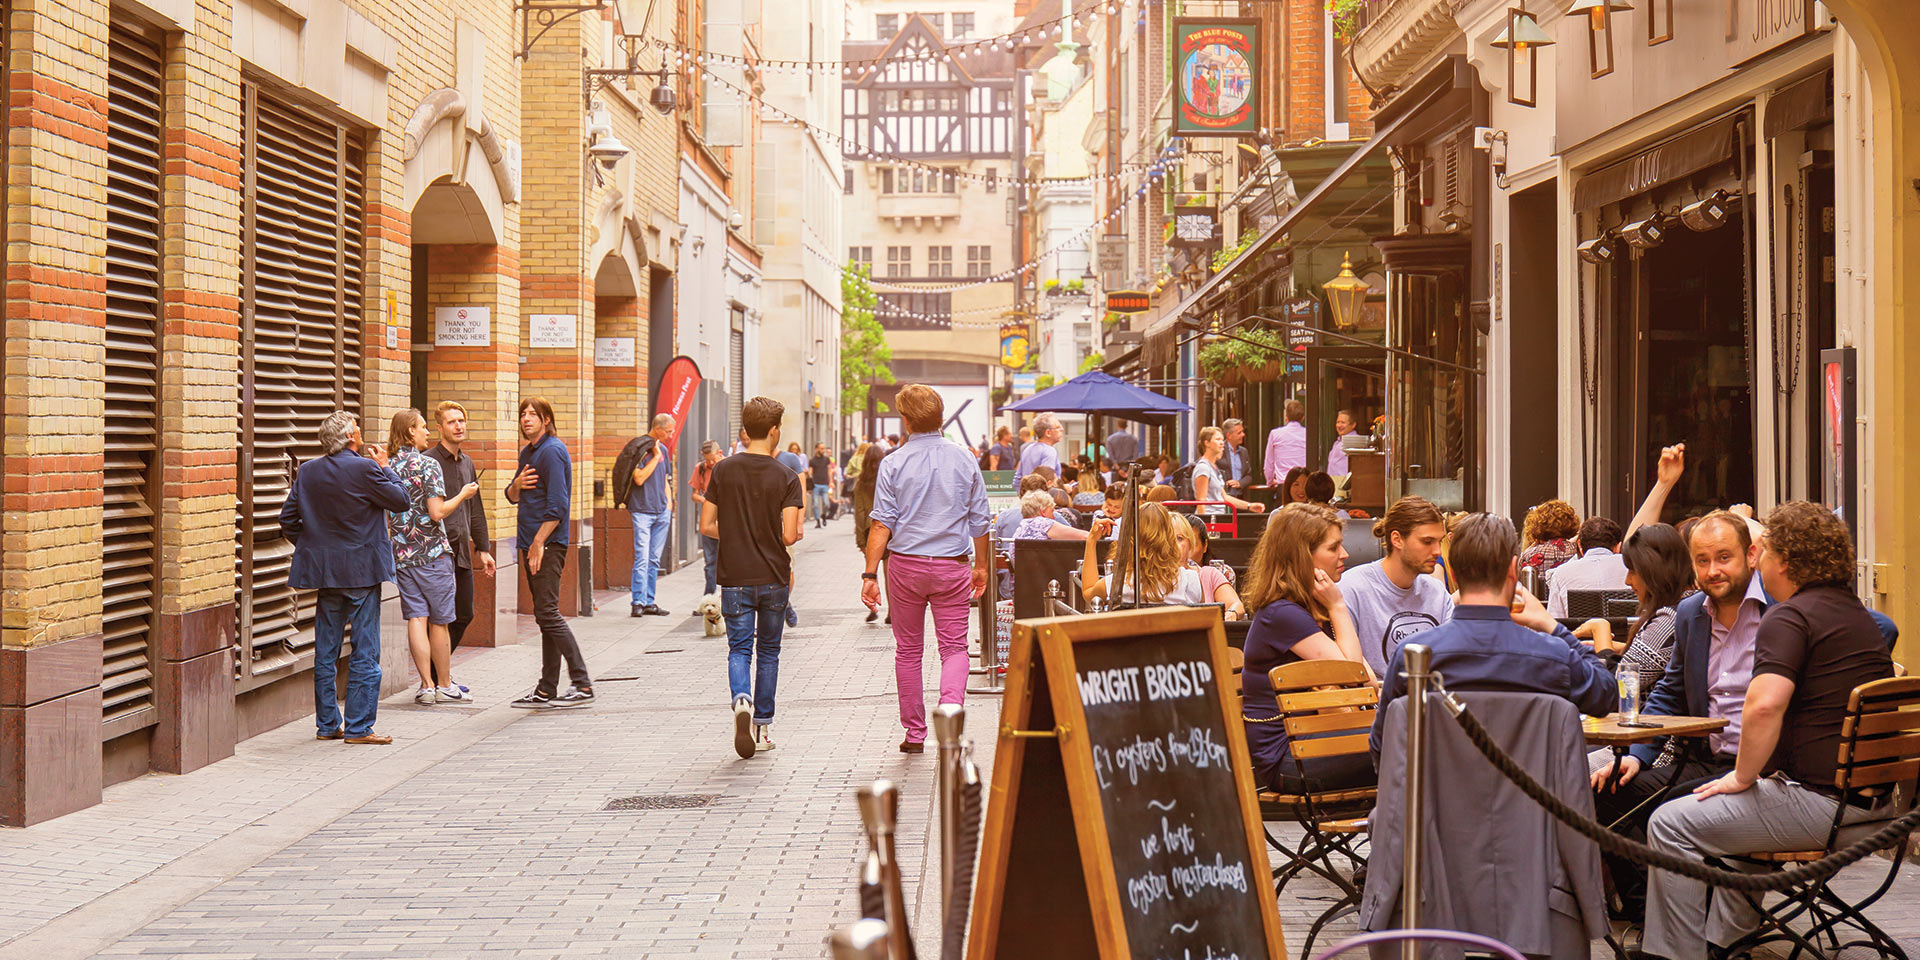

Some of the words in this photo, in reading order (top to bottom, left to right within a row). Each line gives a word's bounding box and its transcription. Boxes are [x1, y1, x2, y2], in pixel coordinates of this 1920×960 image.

[1188, 33, 1202, 41] THE
[1203, 29, 1220, 38] BLUE
[1222, 29, 1243, 40] POSTS
[1289, 336, 1314, 344] UPSTAIRS
[681, 376, 692, 392] First
[1076, 667, 1140, 706] WRIGHT
[1144, 661, 1192, 701] BROS
[1115, 733, 1167, 786] oysters
[1140, 833, 1161, 859] we
[1161, 816, 1195, 855] host
[1127, 869, 1174, 915] oyster
